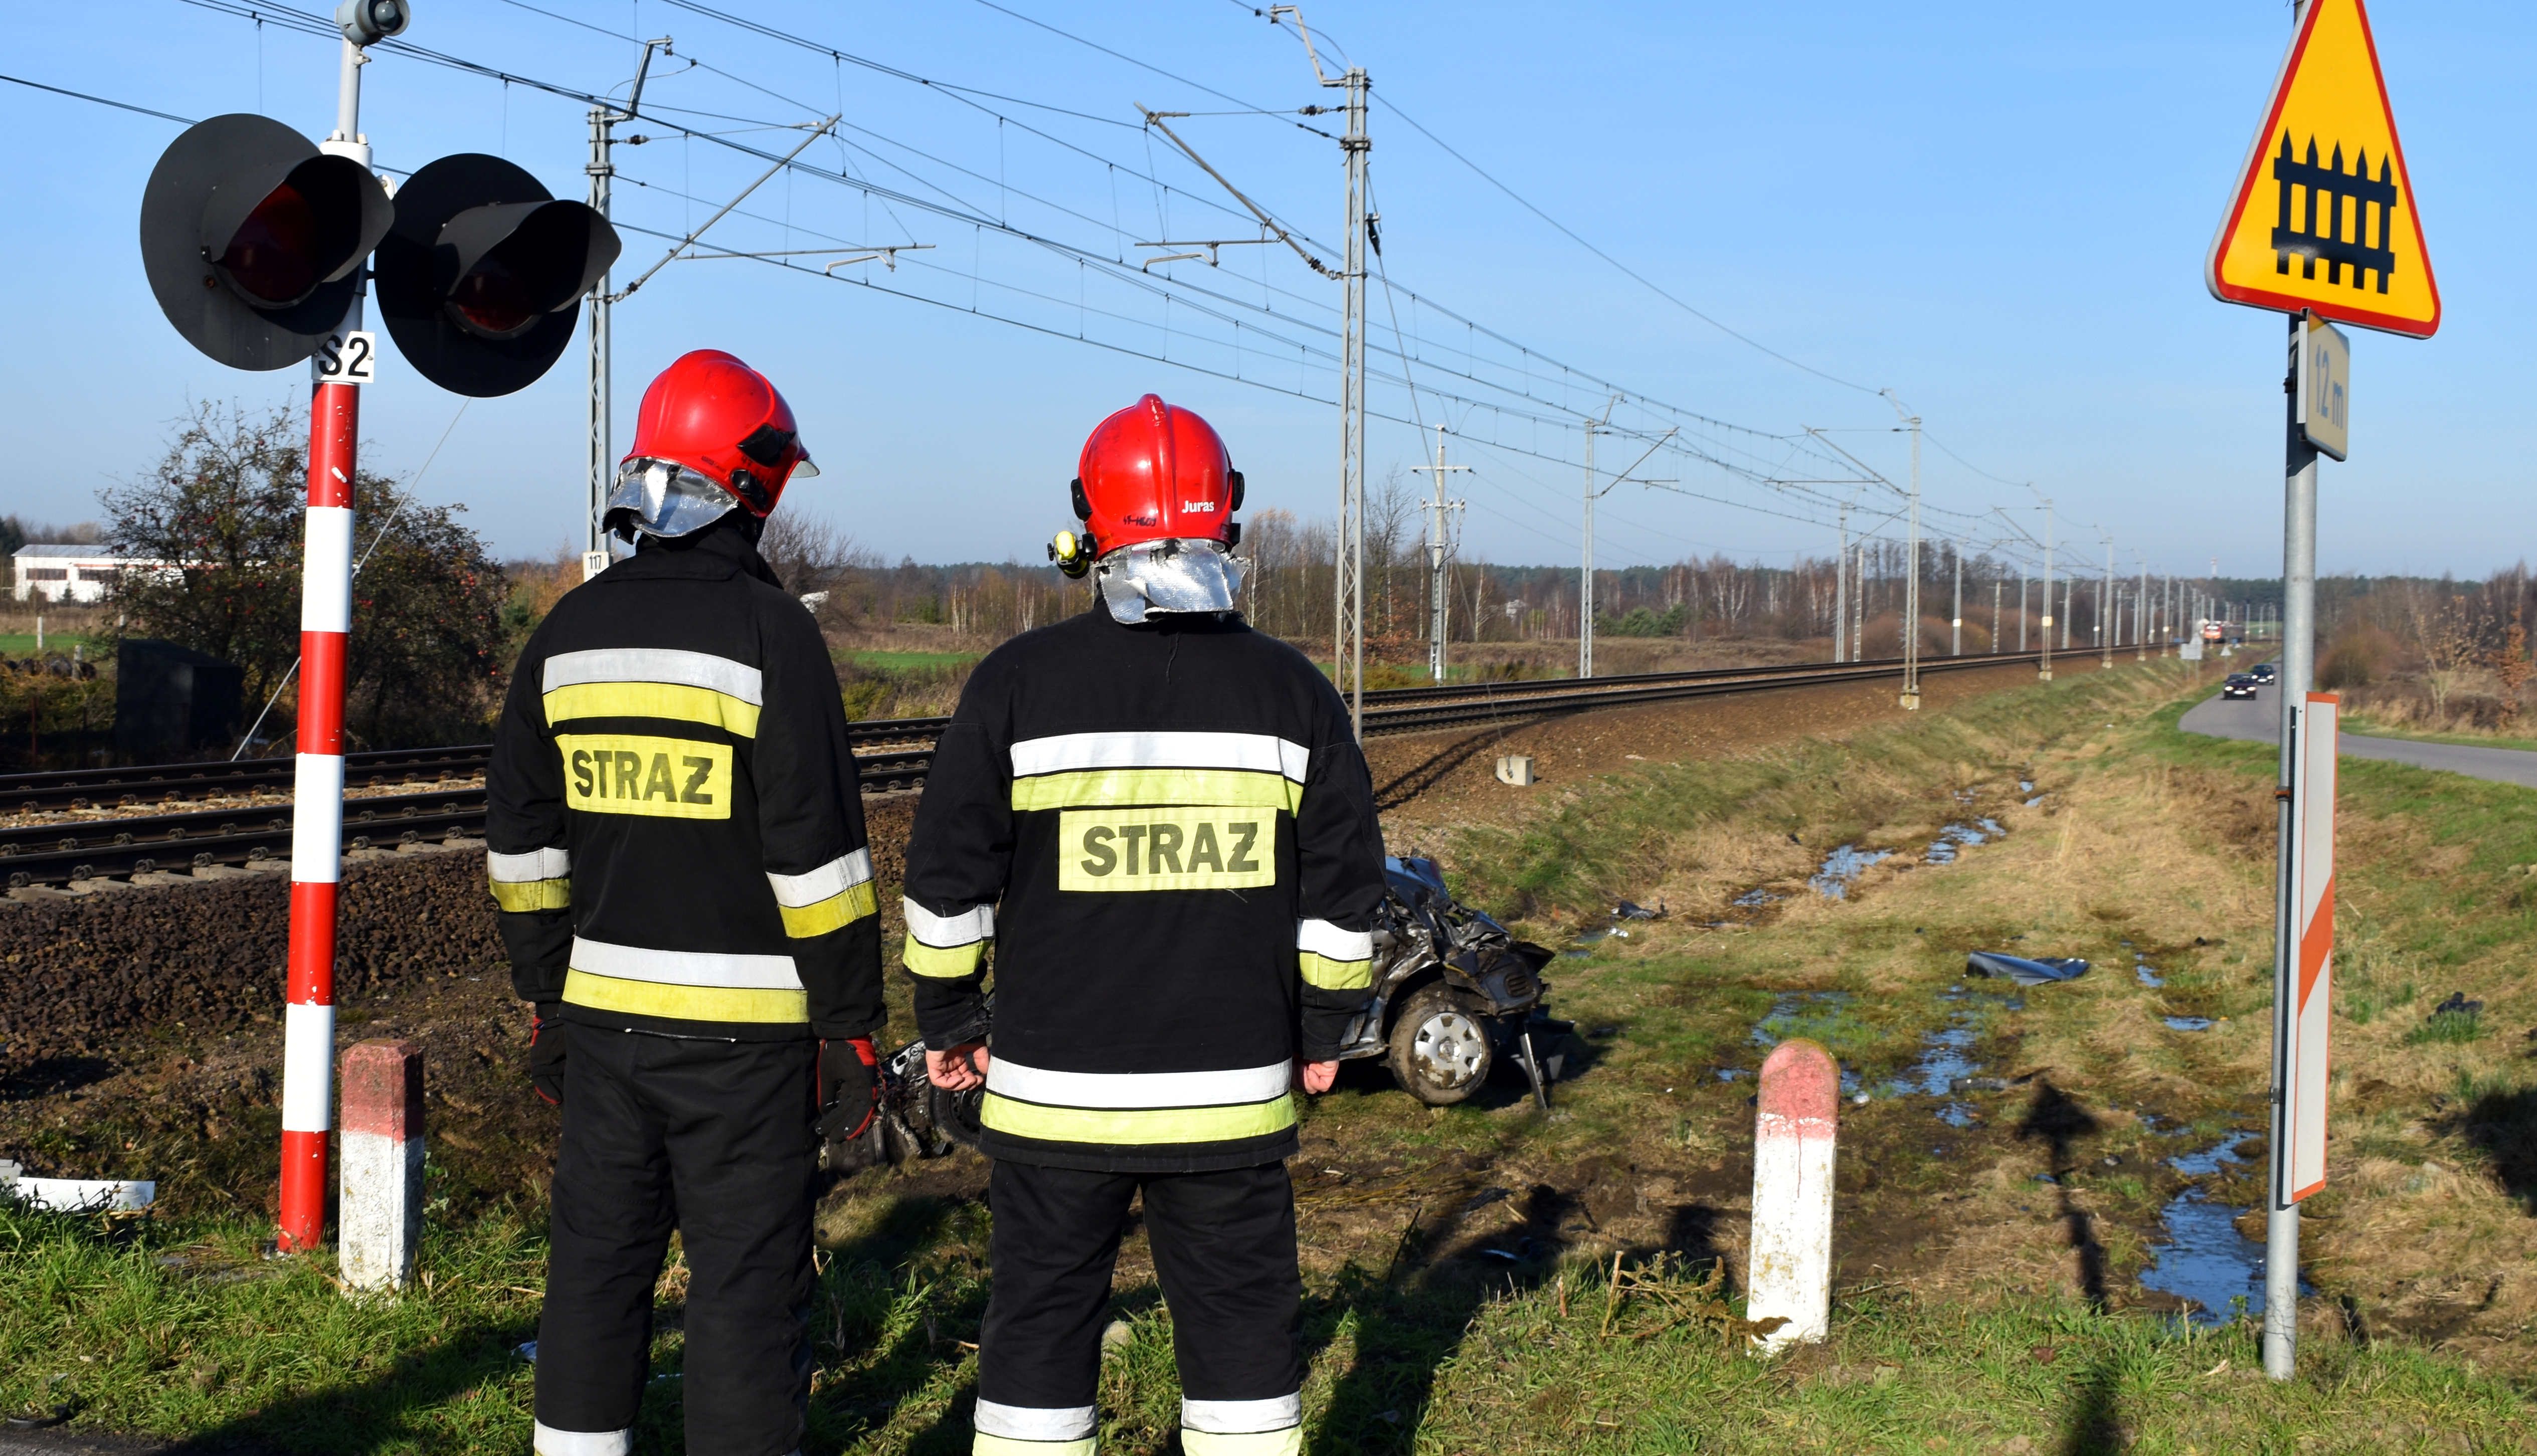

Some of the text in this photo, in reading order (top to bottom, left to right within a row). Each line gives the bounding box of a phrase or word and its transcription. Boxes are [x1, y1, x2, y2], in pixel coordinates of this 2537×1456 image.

[318, 334, 370, 377] S2
[2315, 343, 2343, 430] 12 m
[1182, 500, 1215, 513] Juras
[589, 555, 602, 569] 117
